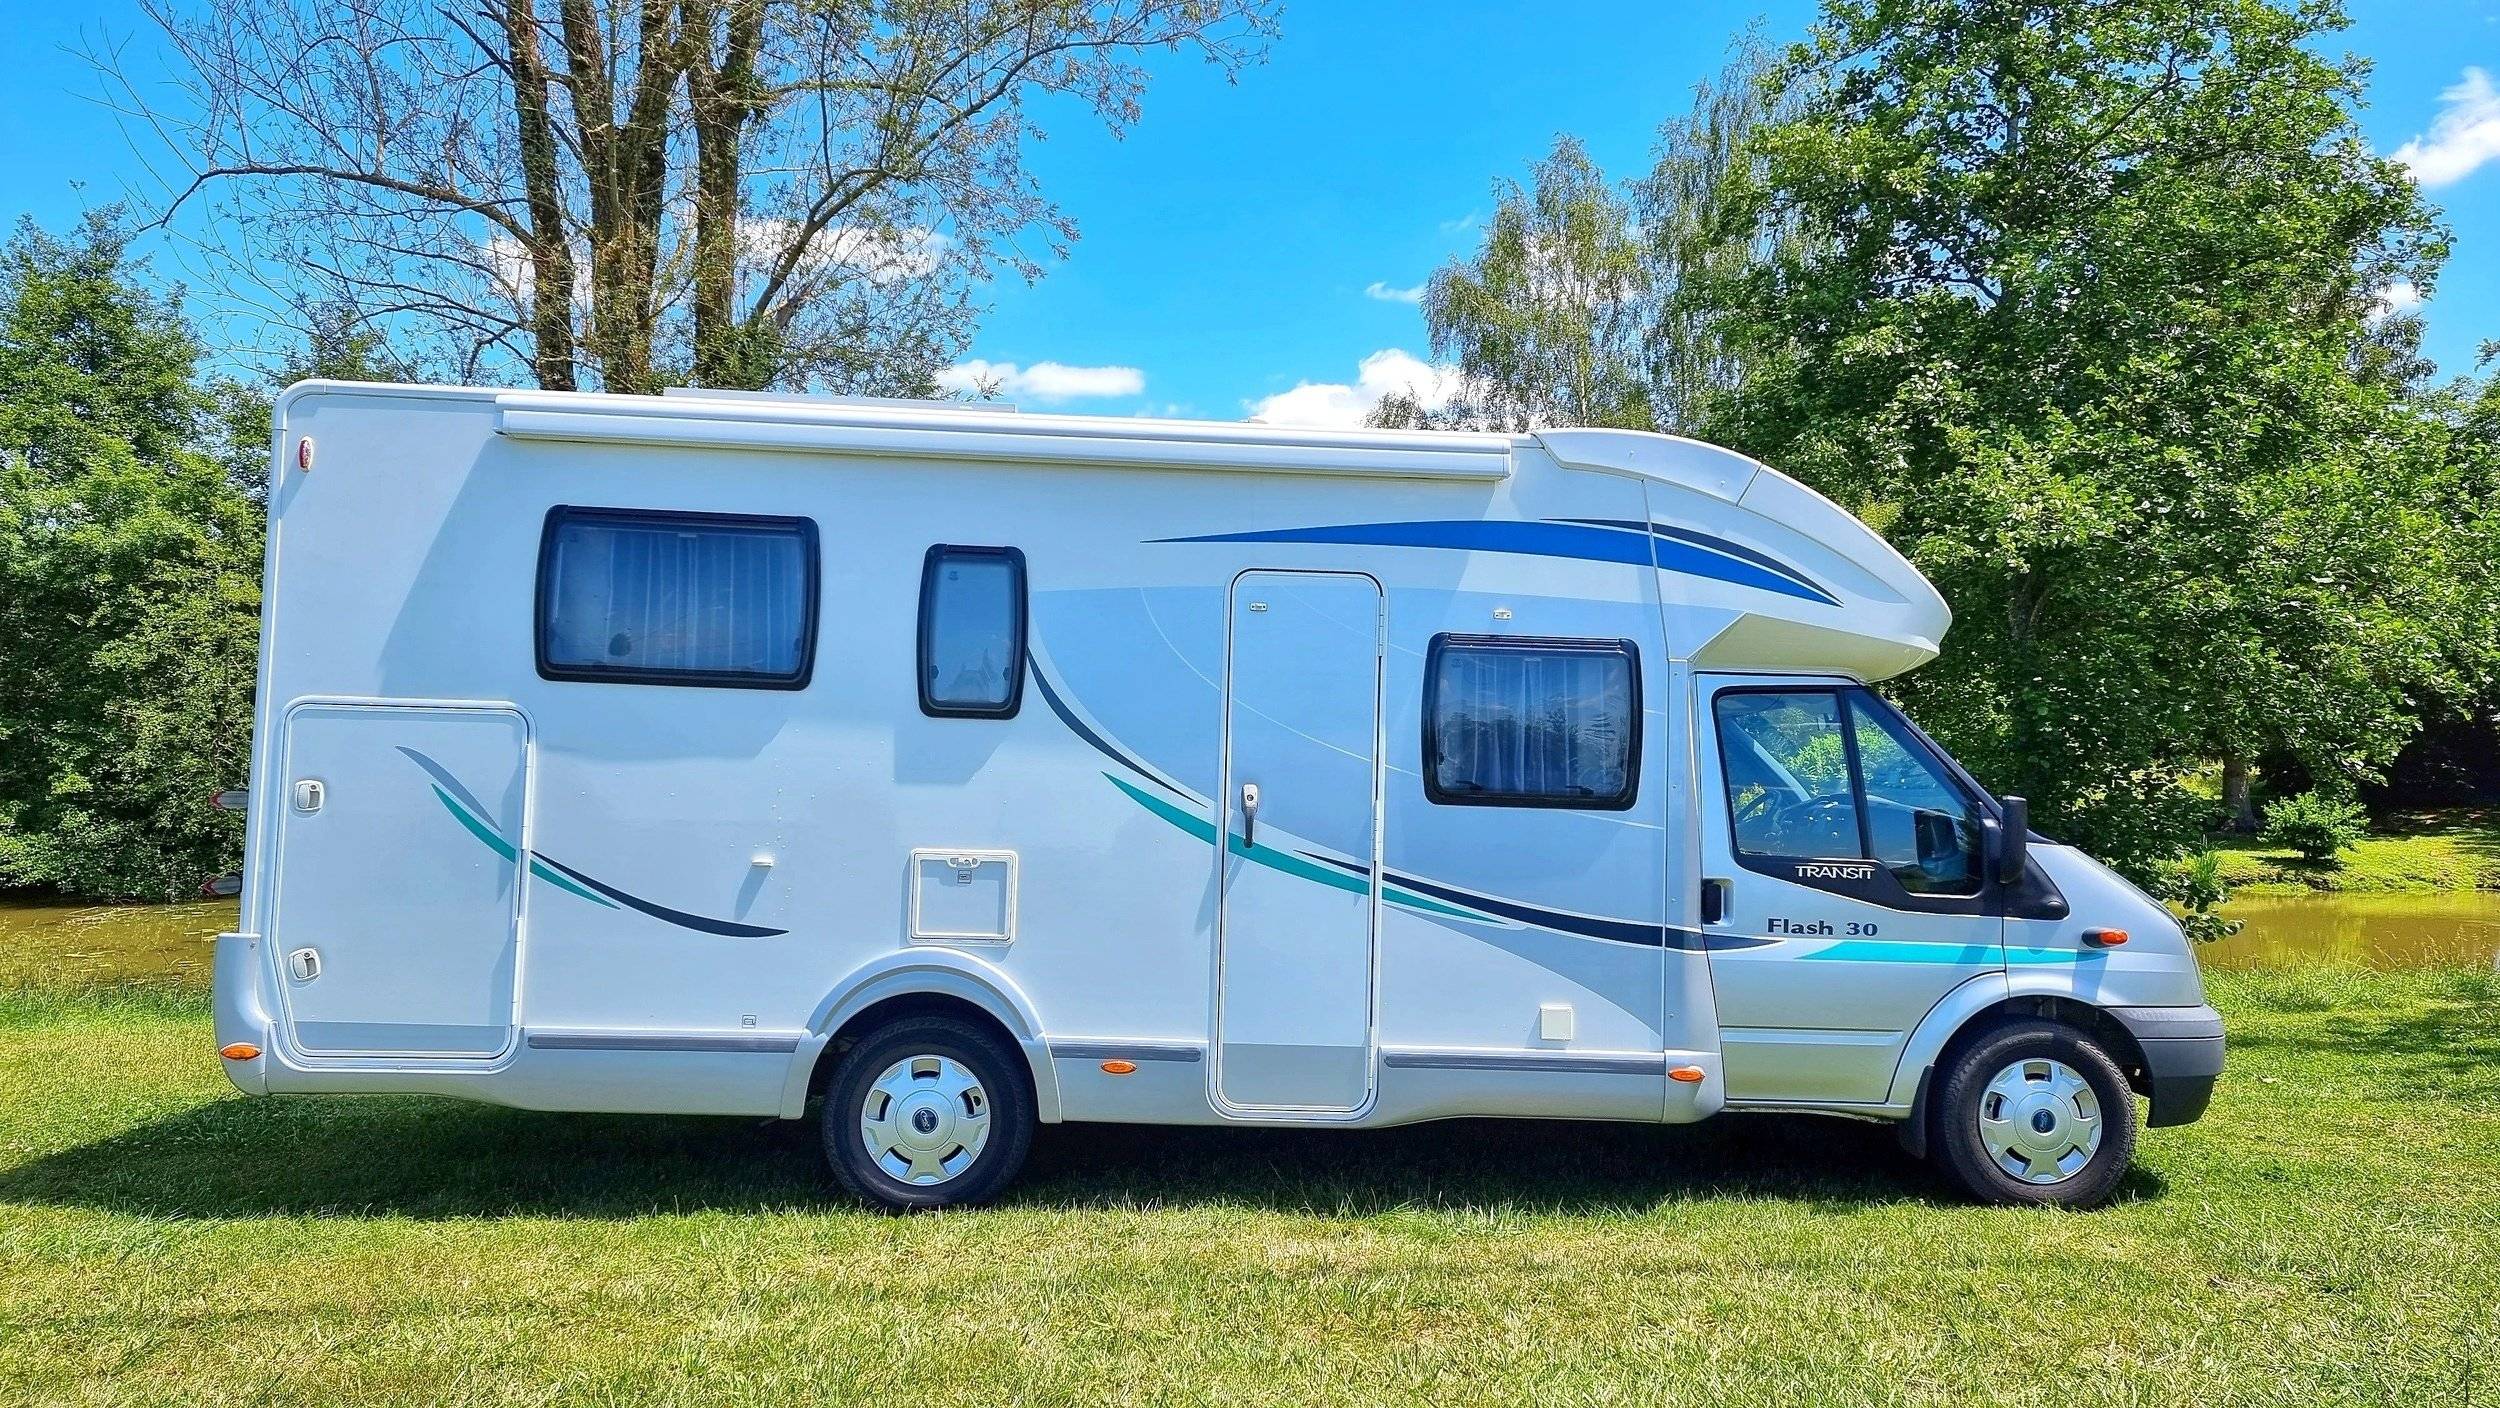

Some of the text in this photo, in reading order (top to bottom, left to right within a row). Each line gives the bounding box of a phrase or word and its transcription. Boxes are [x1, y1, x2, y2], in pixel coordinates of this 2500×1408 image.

[1794, 864, 1876, 880] TRANSIT
[1767, 918, 1878, 937] Flash 30
